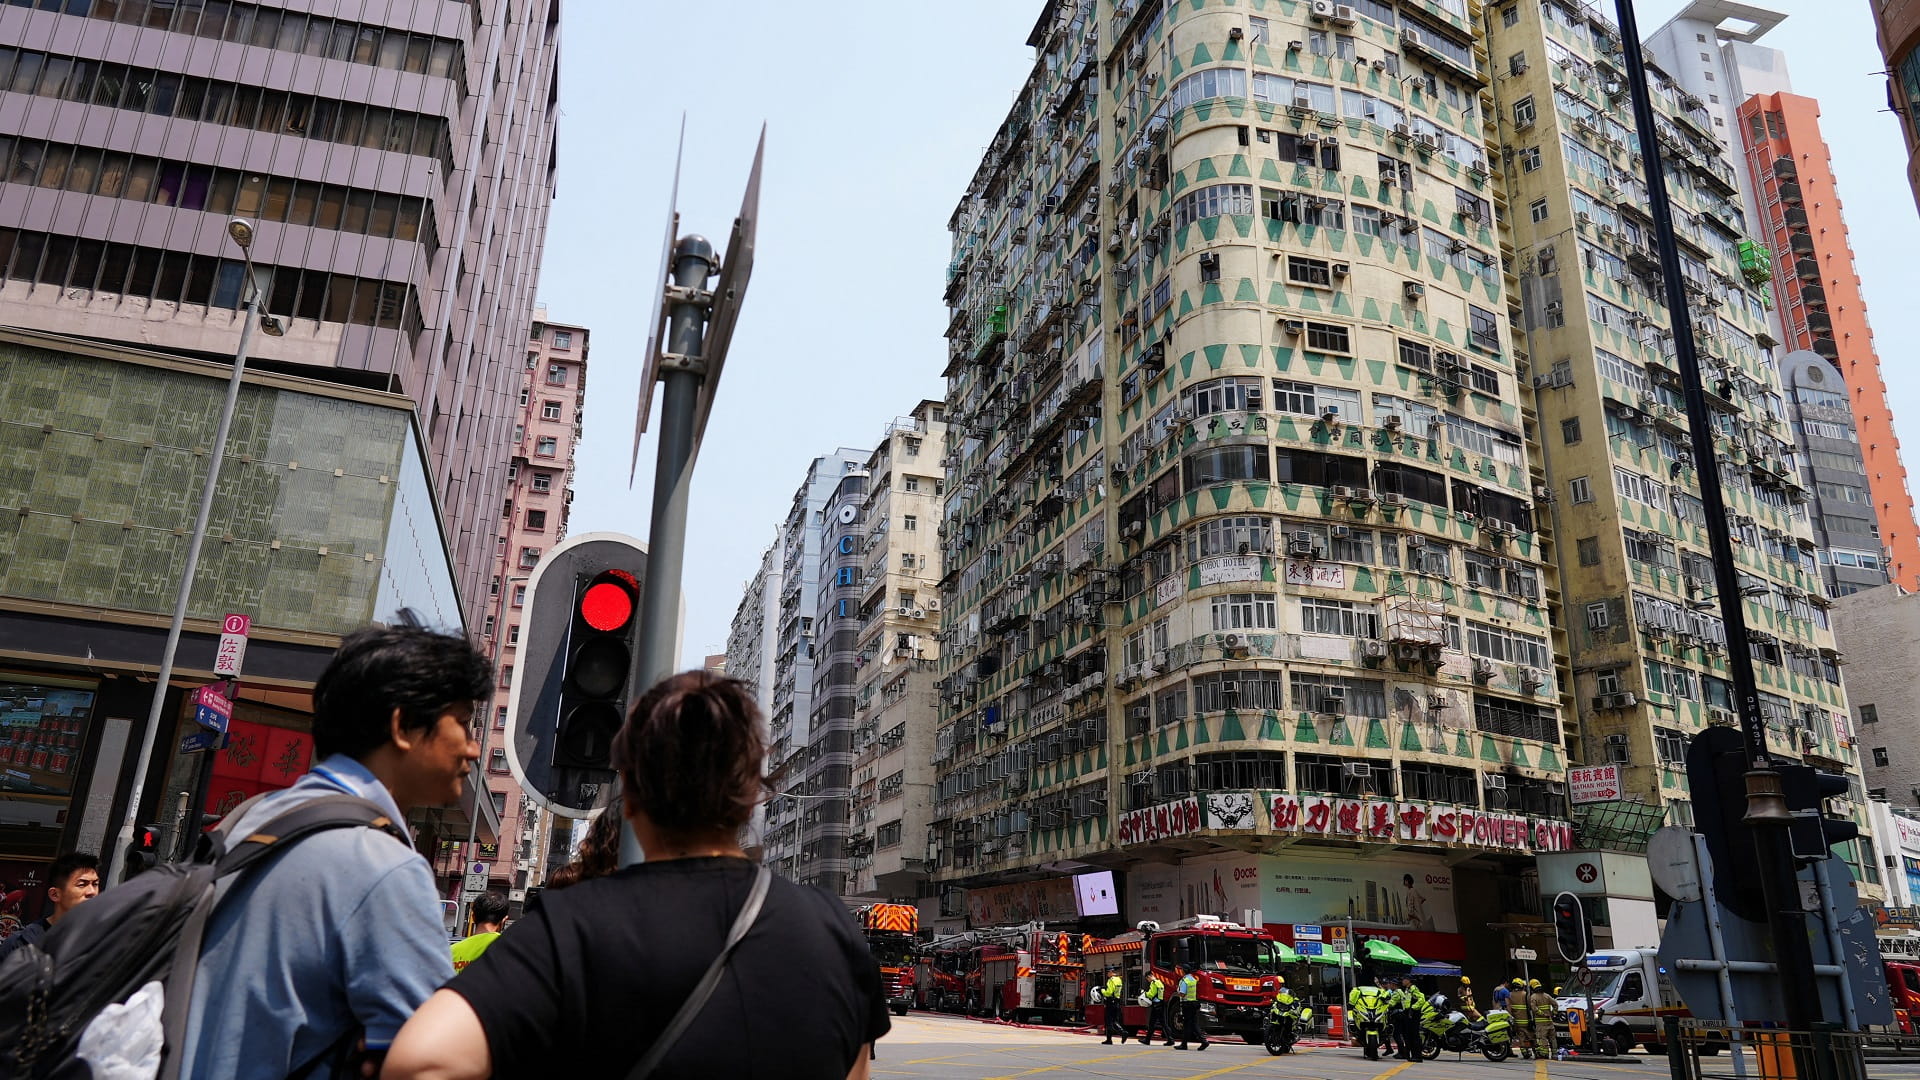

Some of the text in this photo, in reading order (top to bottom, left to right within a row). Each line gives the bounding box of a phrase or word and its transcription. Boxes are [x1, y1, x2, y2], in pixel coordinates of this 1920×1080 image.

[1222, 557, 1247, 567] HOTEL
[217, 638, 238, 671] 佐敦
[1572, 767, 1615, 783] 蘇杭賓館
[1271, 797, 1456, 838] 動力健美中心
[1461, 814, 1528, 844] POWER
